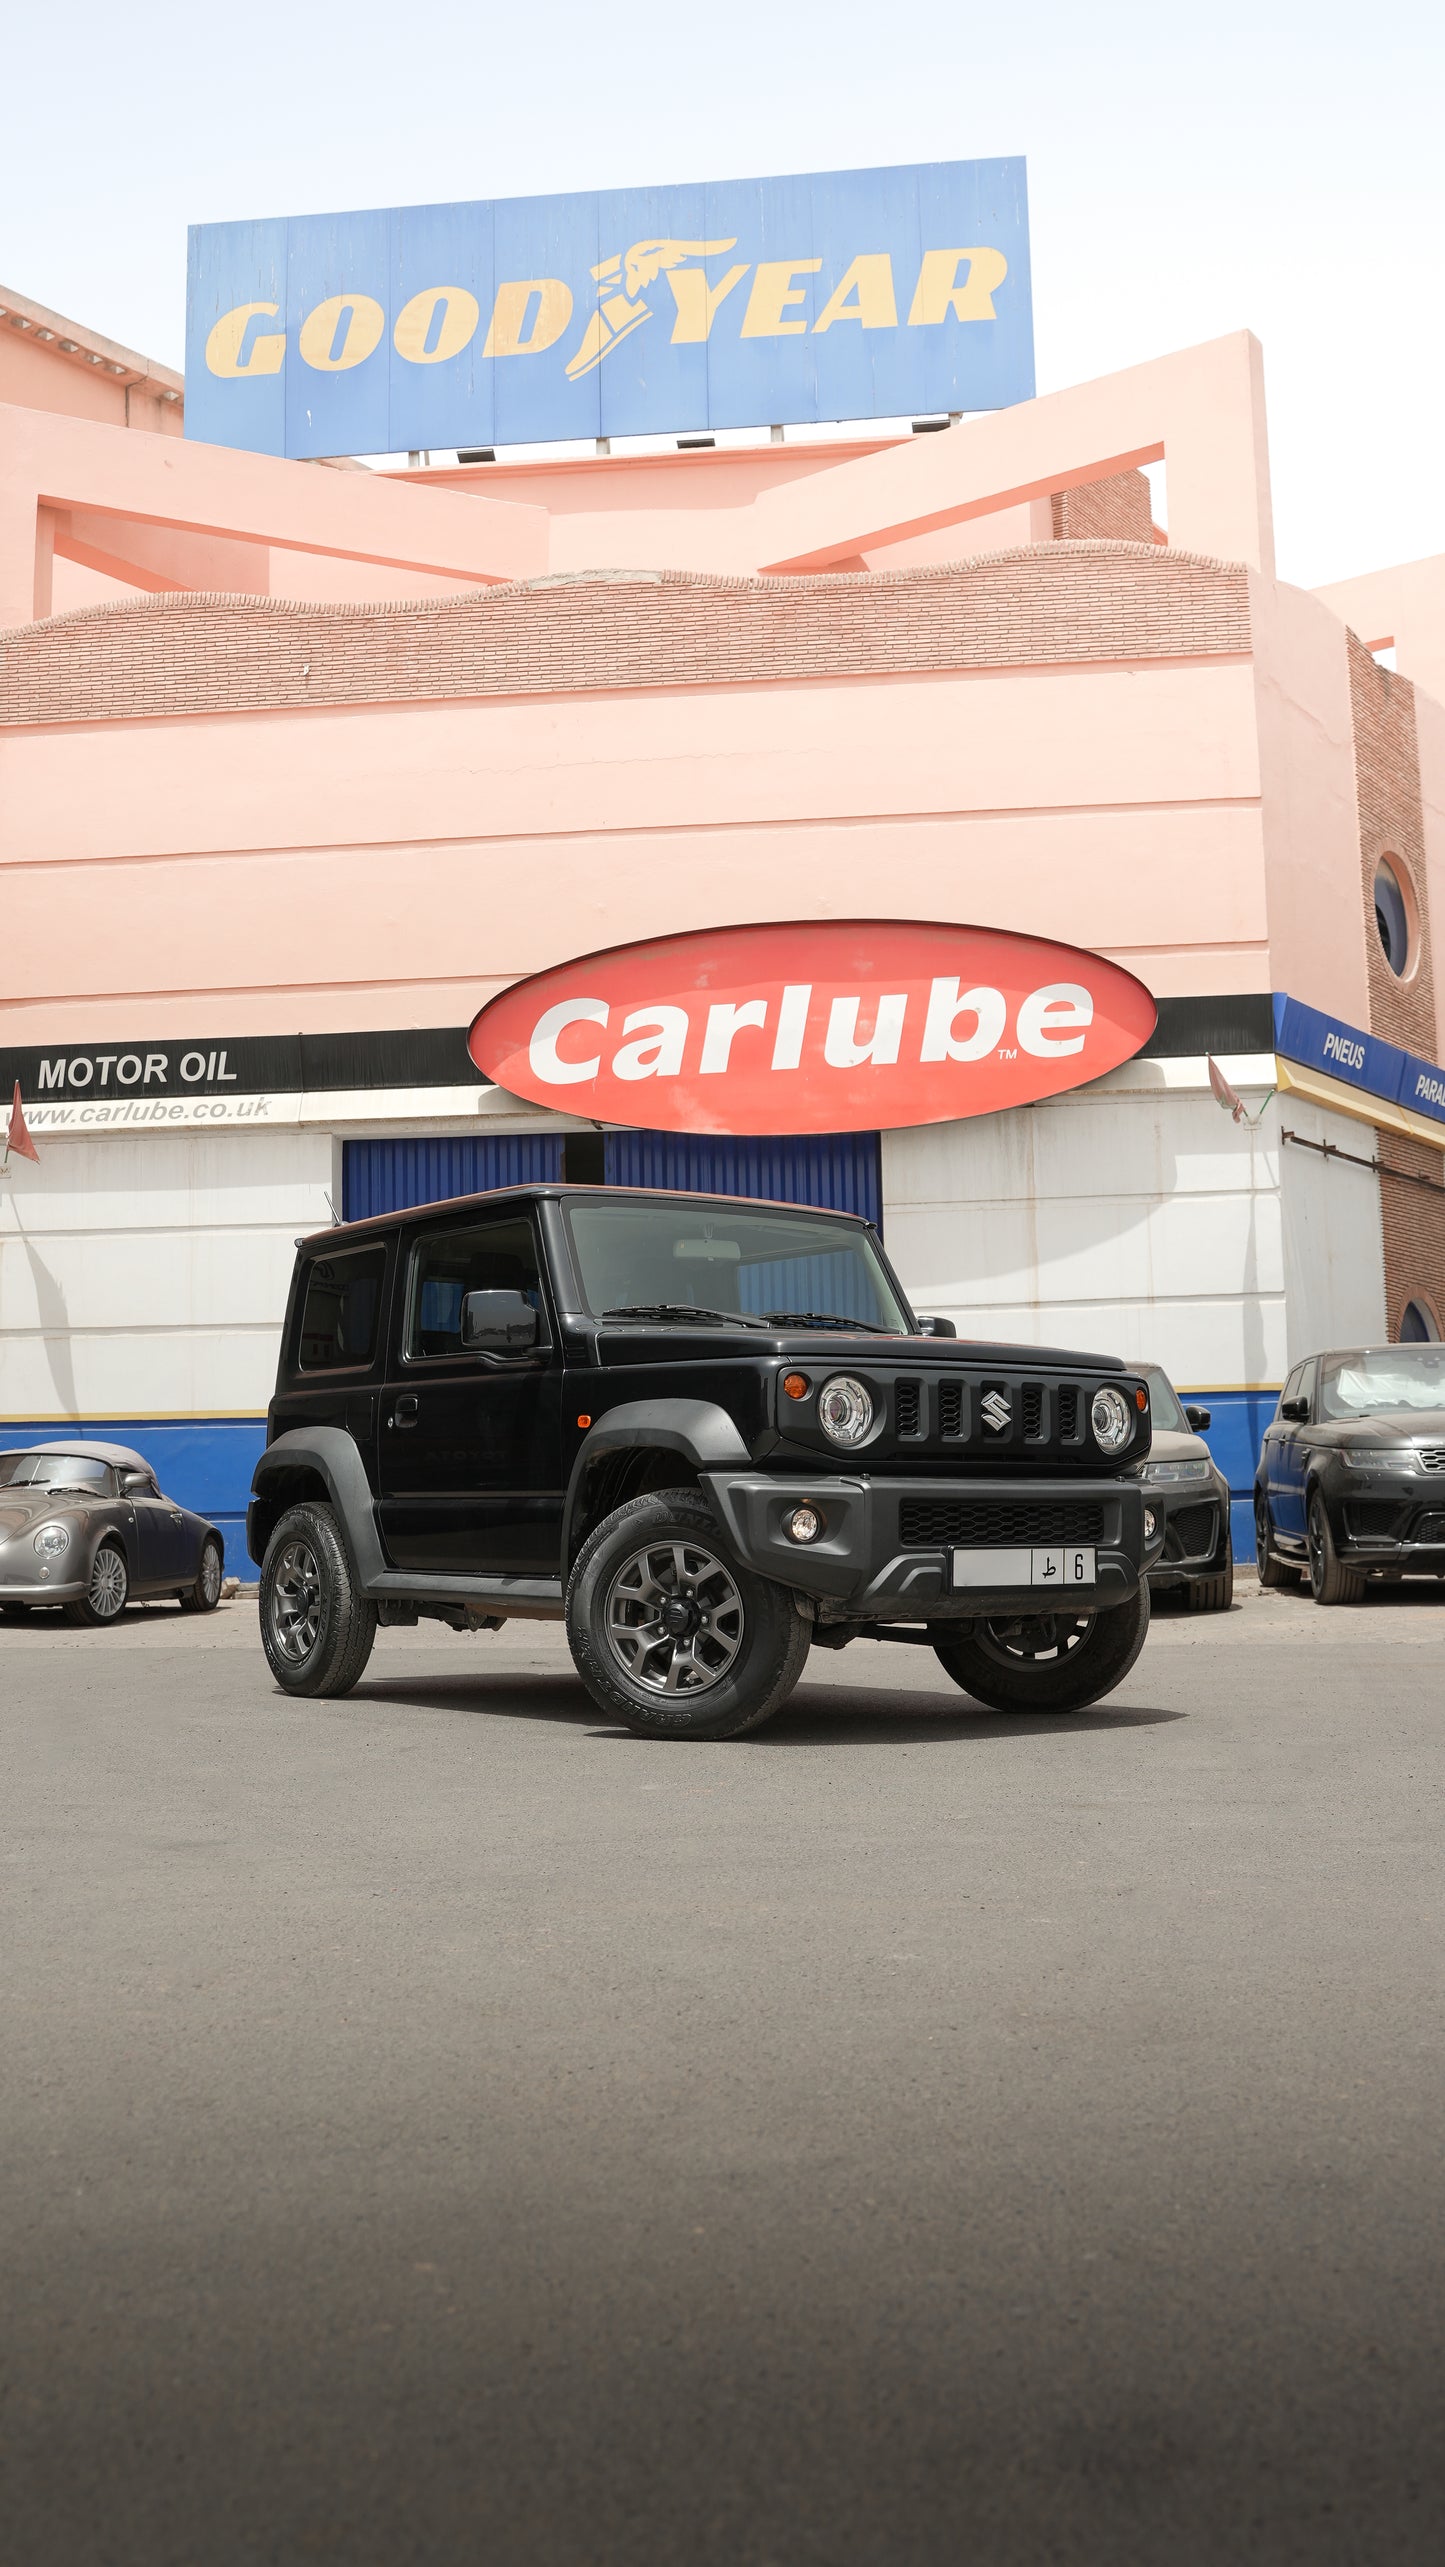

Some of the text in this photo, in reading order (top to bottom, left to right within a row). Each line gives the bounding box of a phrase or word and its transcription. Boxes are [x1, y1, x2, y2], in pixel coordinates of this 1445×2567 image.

[206, 247, 1008, 378] GOOD YEAR
[528, 976, 1094, 1085] Carlube
[38, 1051, 238, 1089] MOTOR OIL
[1323, 1032, 1366, 1070] PNEUS
[1042, 1553, 1084, 1581] ط 6
